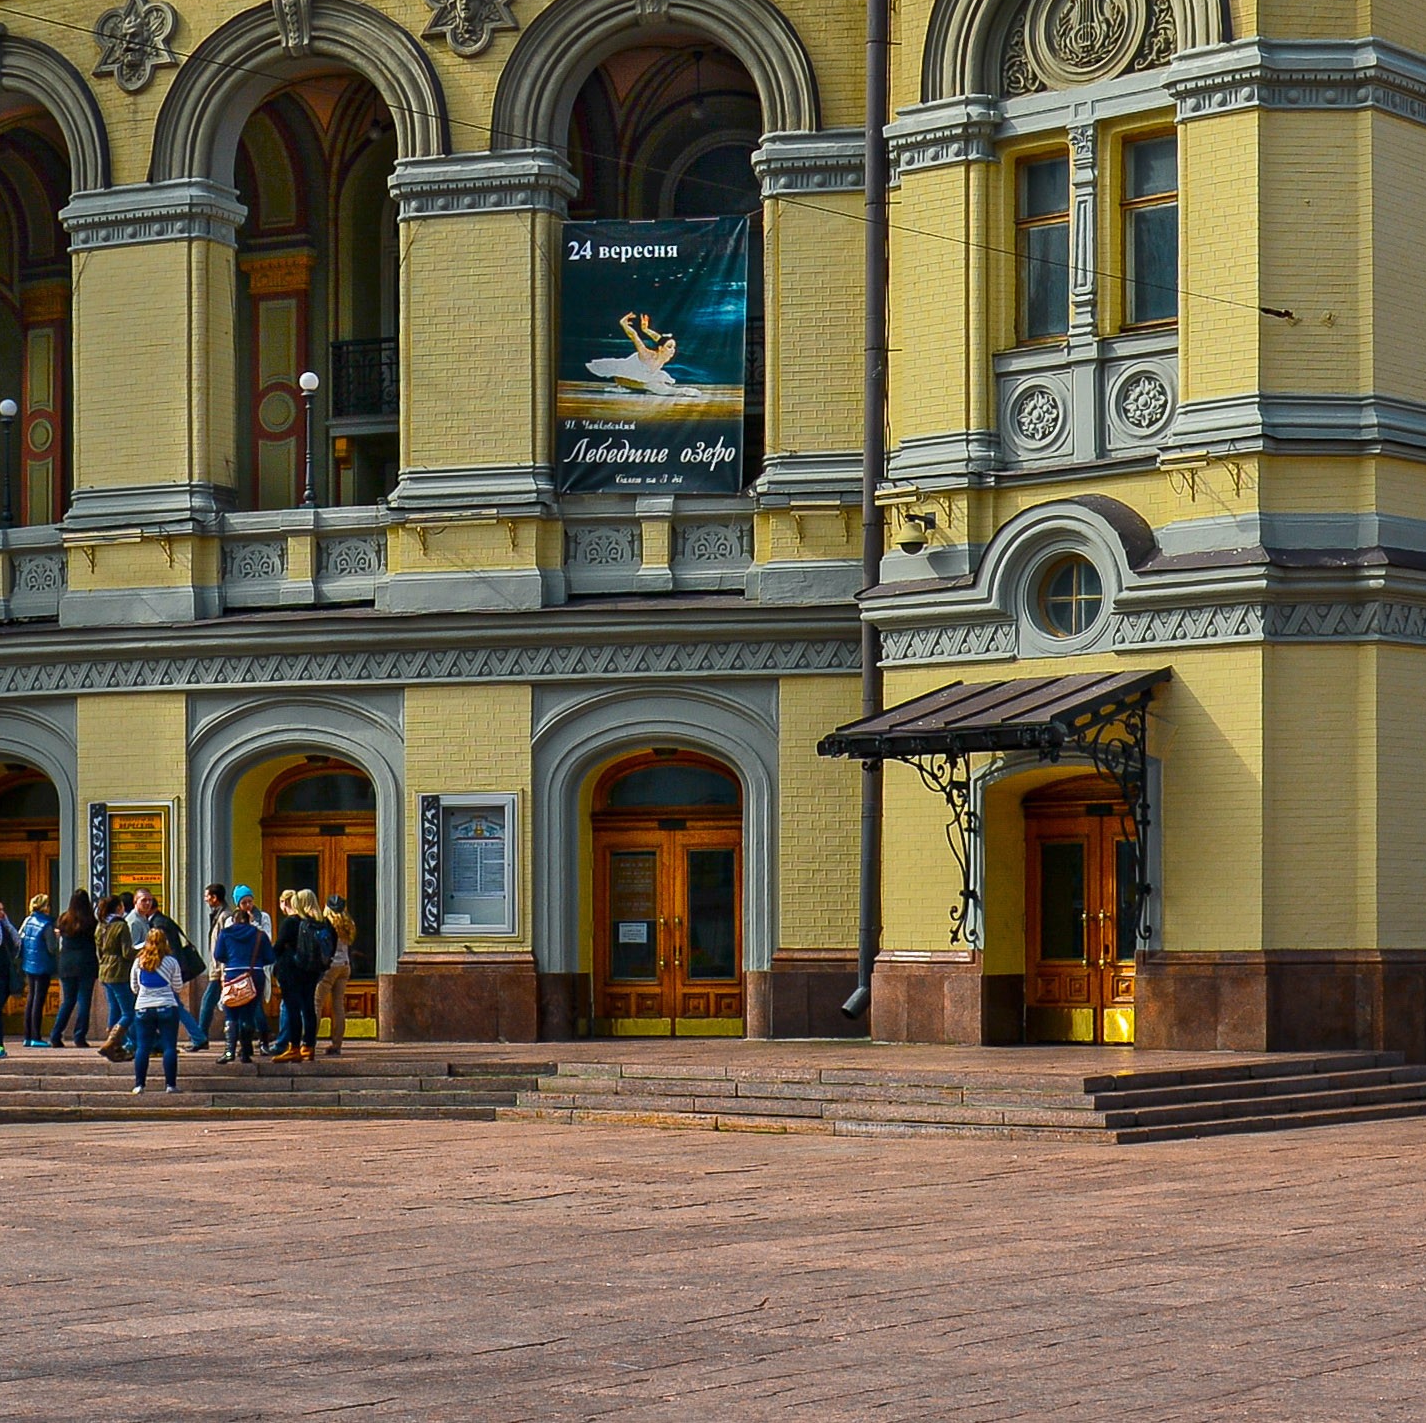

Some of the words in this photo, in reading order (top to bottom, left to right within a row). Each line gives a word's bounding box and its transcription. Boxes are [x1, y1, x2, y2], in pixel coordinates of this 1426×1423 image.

[567, 240, 593, 261] 24
[598, 244, 679, 263] вересня
[563, 437, 670, 464] Лебедине
[680, 435, 737, 472] озеро
